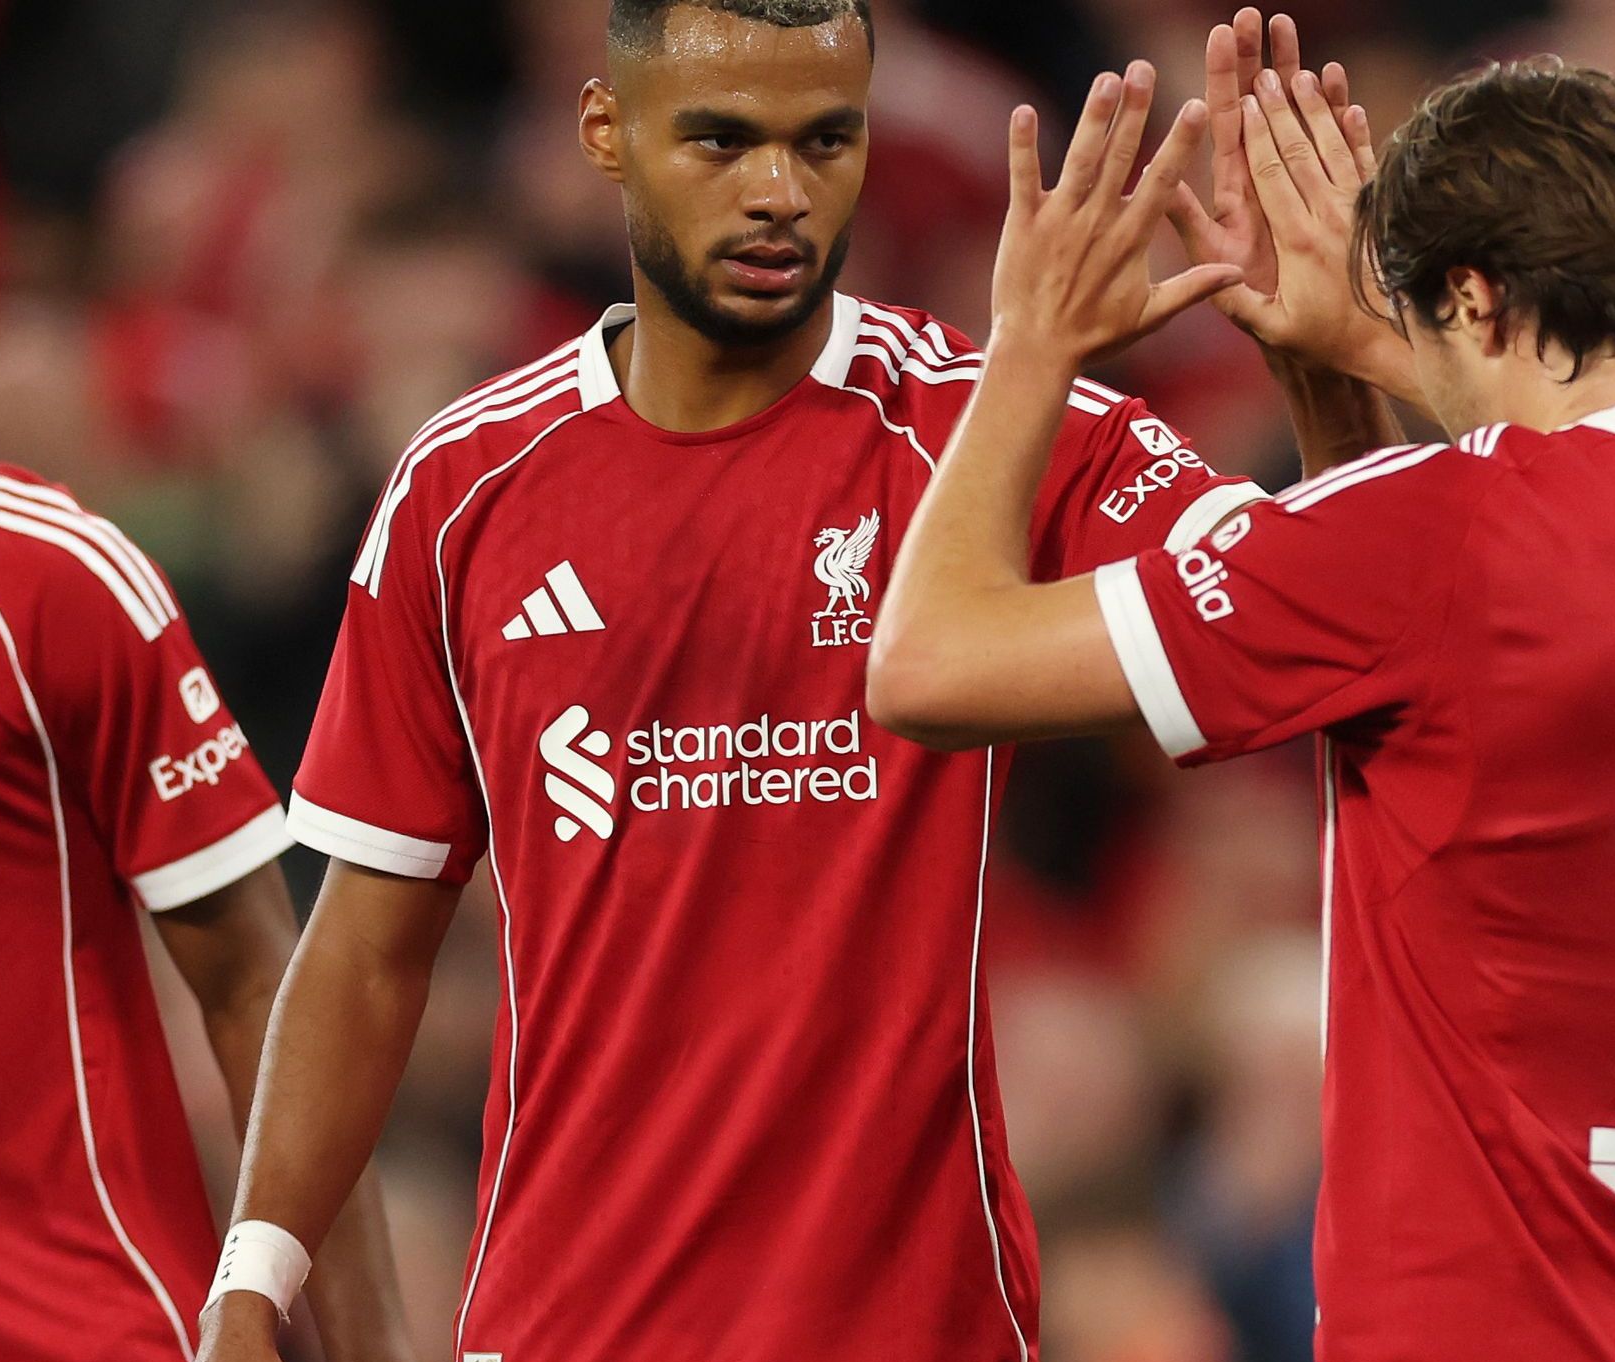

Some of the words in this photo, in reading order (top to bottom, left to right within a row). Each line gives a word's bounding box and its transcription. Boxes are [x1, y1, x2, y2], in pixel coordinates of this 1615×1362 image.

[1098, 448, 1218, 525] Expe
[626, 708, 861, 766] standard
[629, 755, 879, 812] chartered
